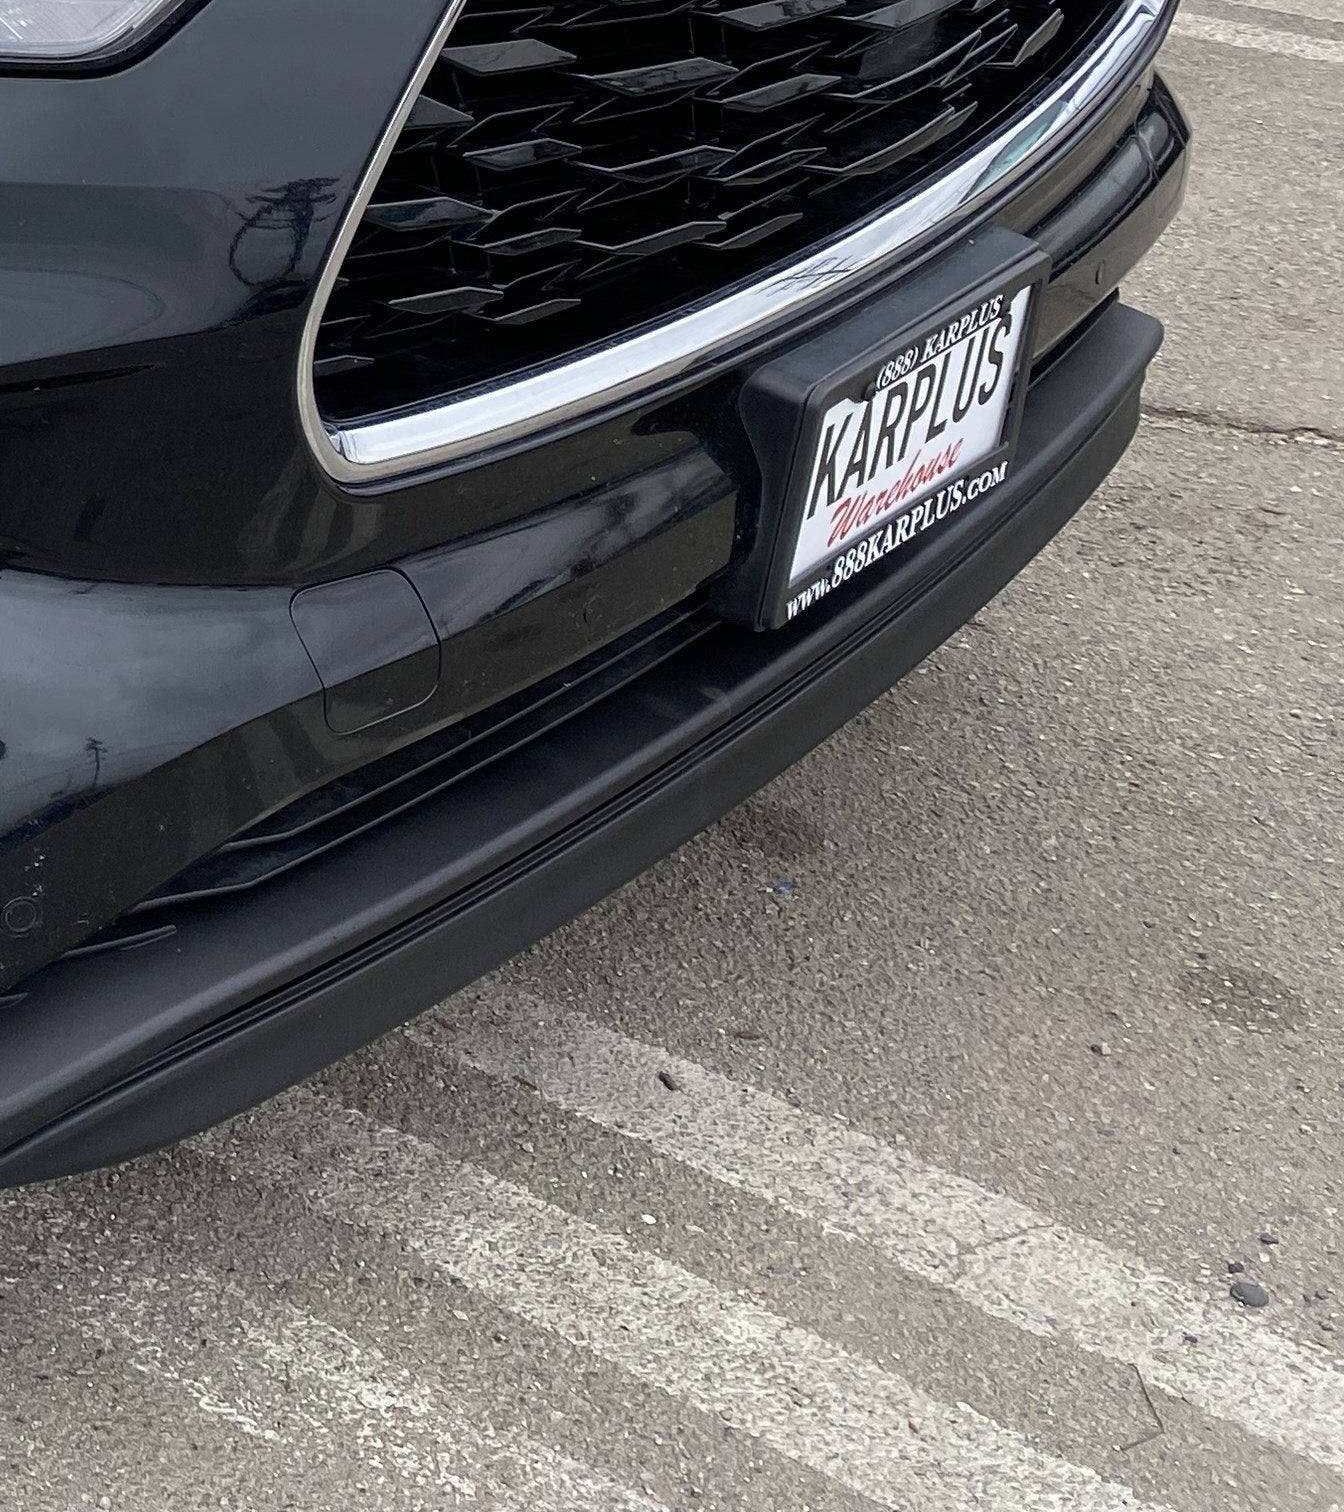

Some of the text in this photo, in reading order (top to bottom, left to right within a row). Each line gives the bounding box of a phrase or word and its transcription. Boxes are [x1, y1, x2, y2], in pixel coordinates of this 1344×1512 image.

[876, 294, 1003, 389] (888) KARPLUS
[807, 314, 1011, 520] KARPLUS
[827, 438, 964, 548] Warehouse
